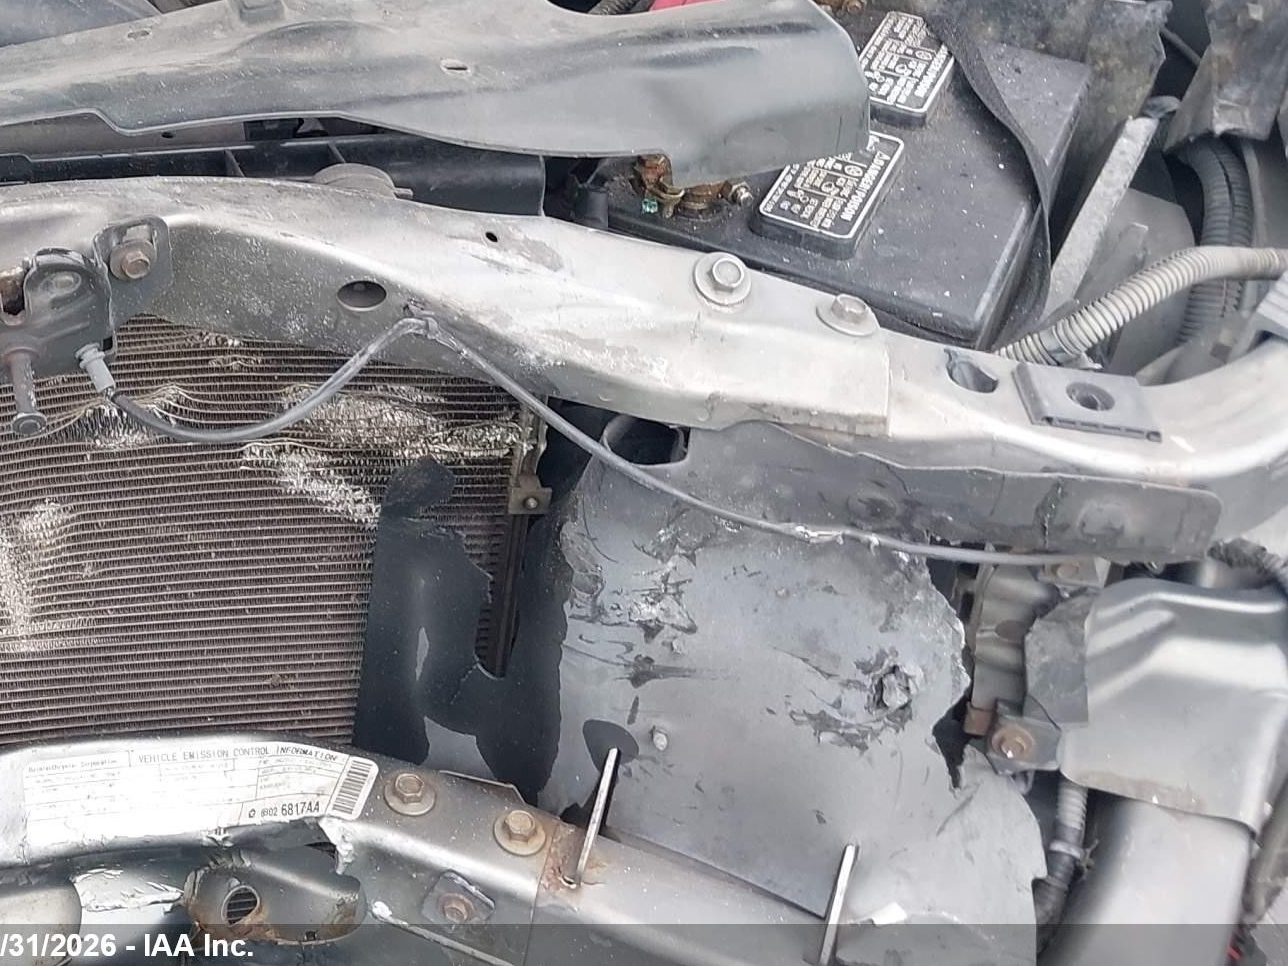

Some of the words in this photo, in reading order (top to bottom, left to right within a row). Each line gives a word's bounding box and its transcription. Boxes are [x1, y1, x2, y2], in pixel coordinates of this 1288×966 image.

[138, 752, 178, 764] VEHICLE
[183, 749, 229, 761] EMISSION
[233, 745, 269, 758] CONTROL
[276, 745, 338, 762] INFORMATION
